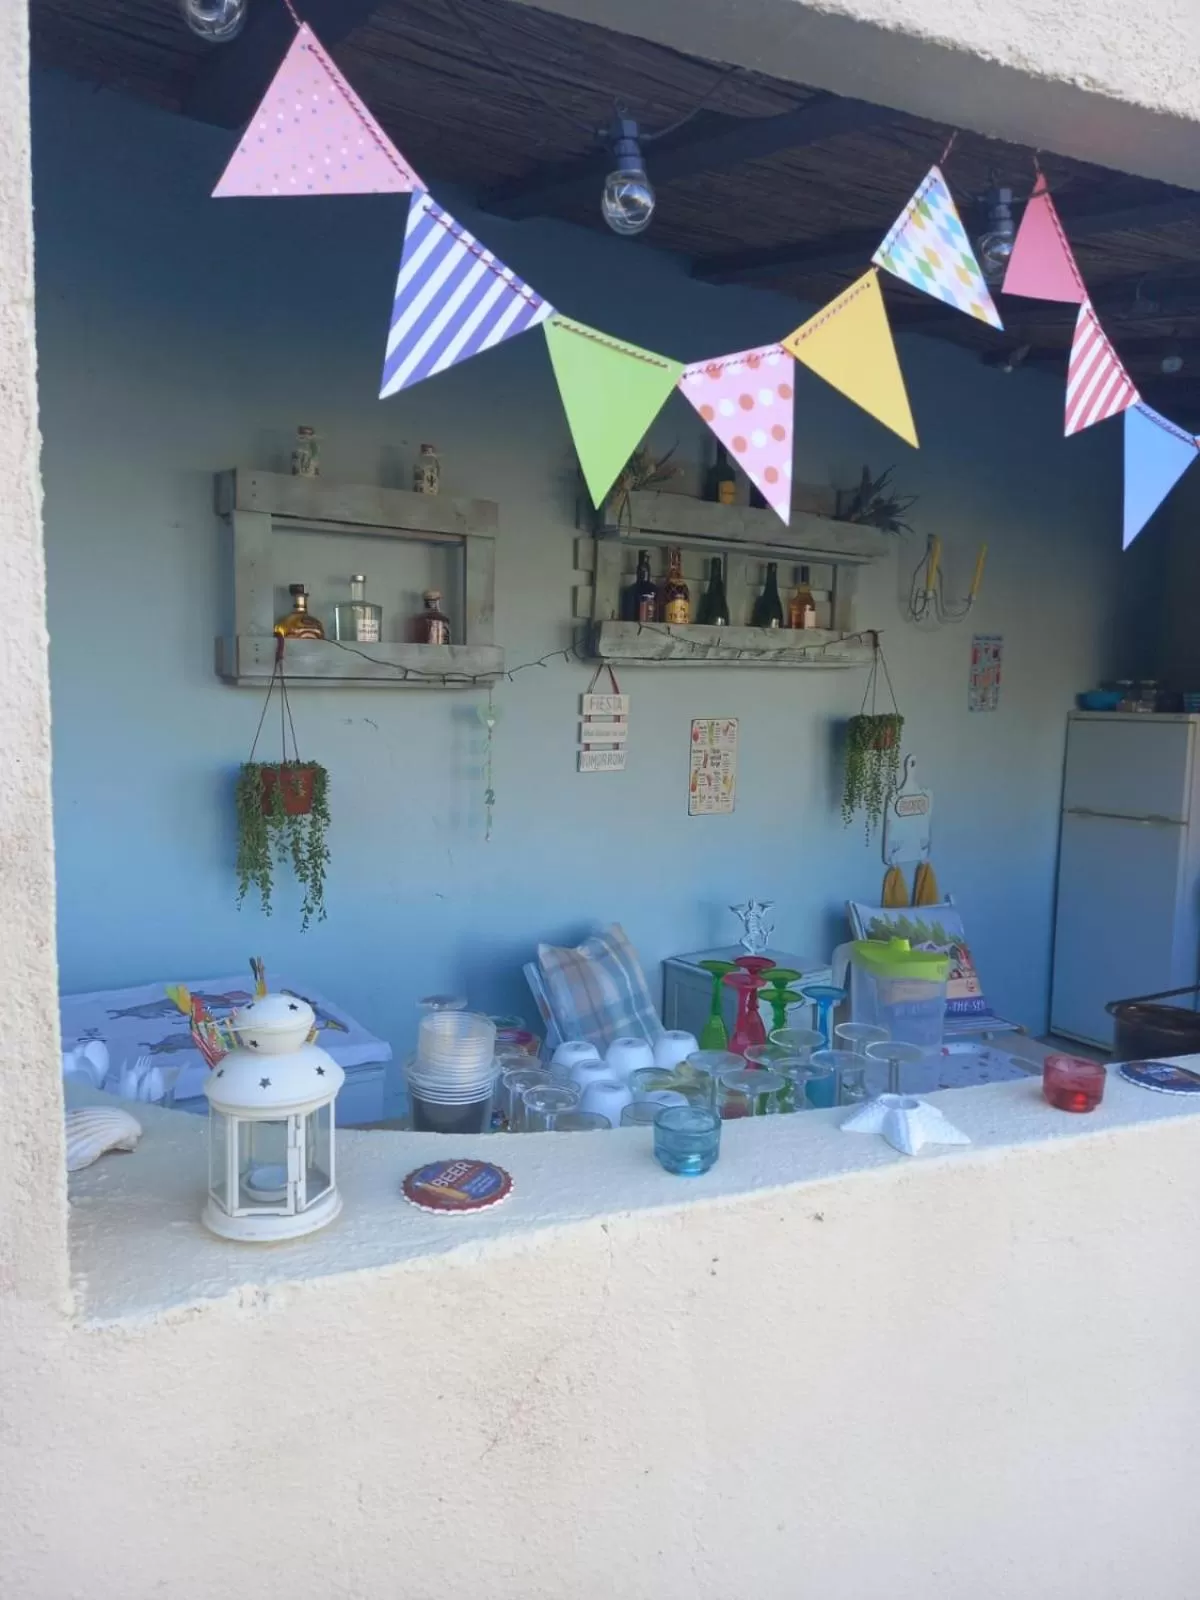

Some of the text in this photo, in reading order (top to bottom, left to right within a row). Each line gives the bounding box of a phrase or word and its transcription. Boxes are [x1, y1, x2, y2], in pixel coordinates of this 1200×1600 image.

[589, 696, 623, 712] FIESTA
[582, 753, 626, 769] TOMORROW
[431, 1161, 474, 1188] BEER
